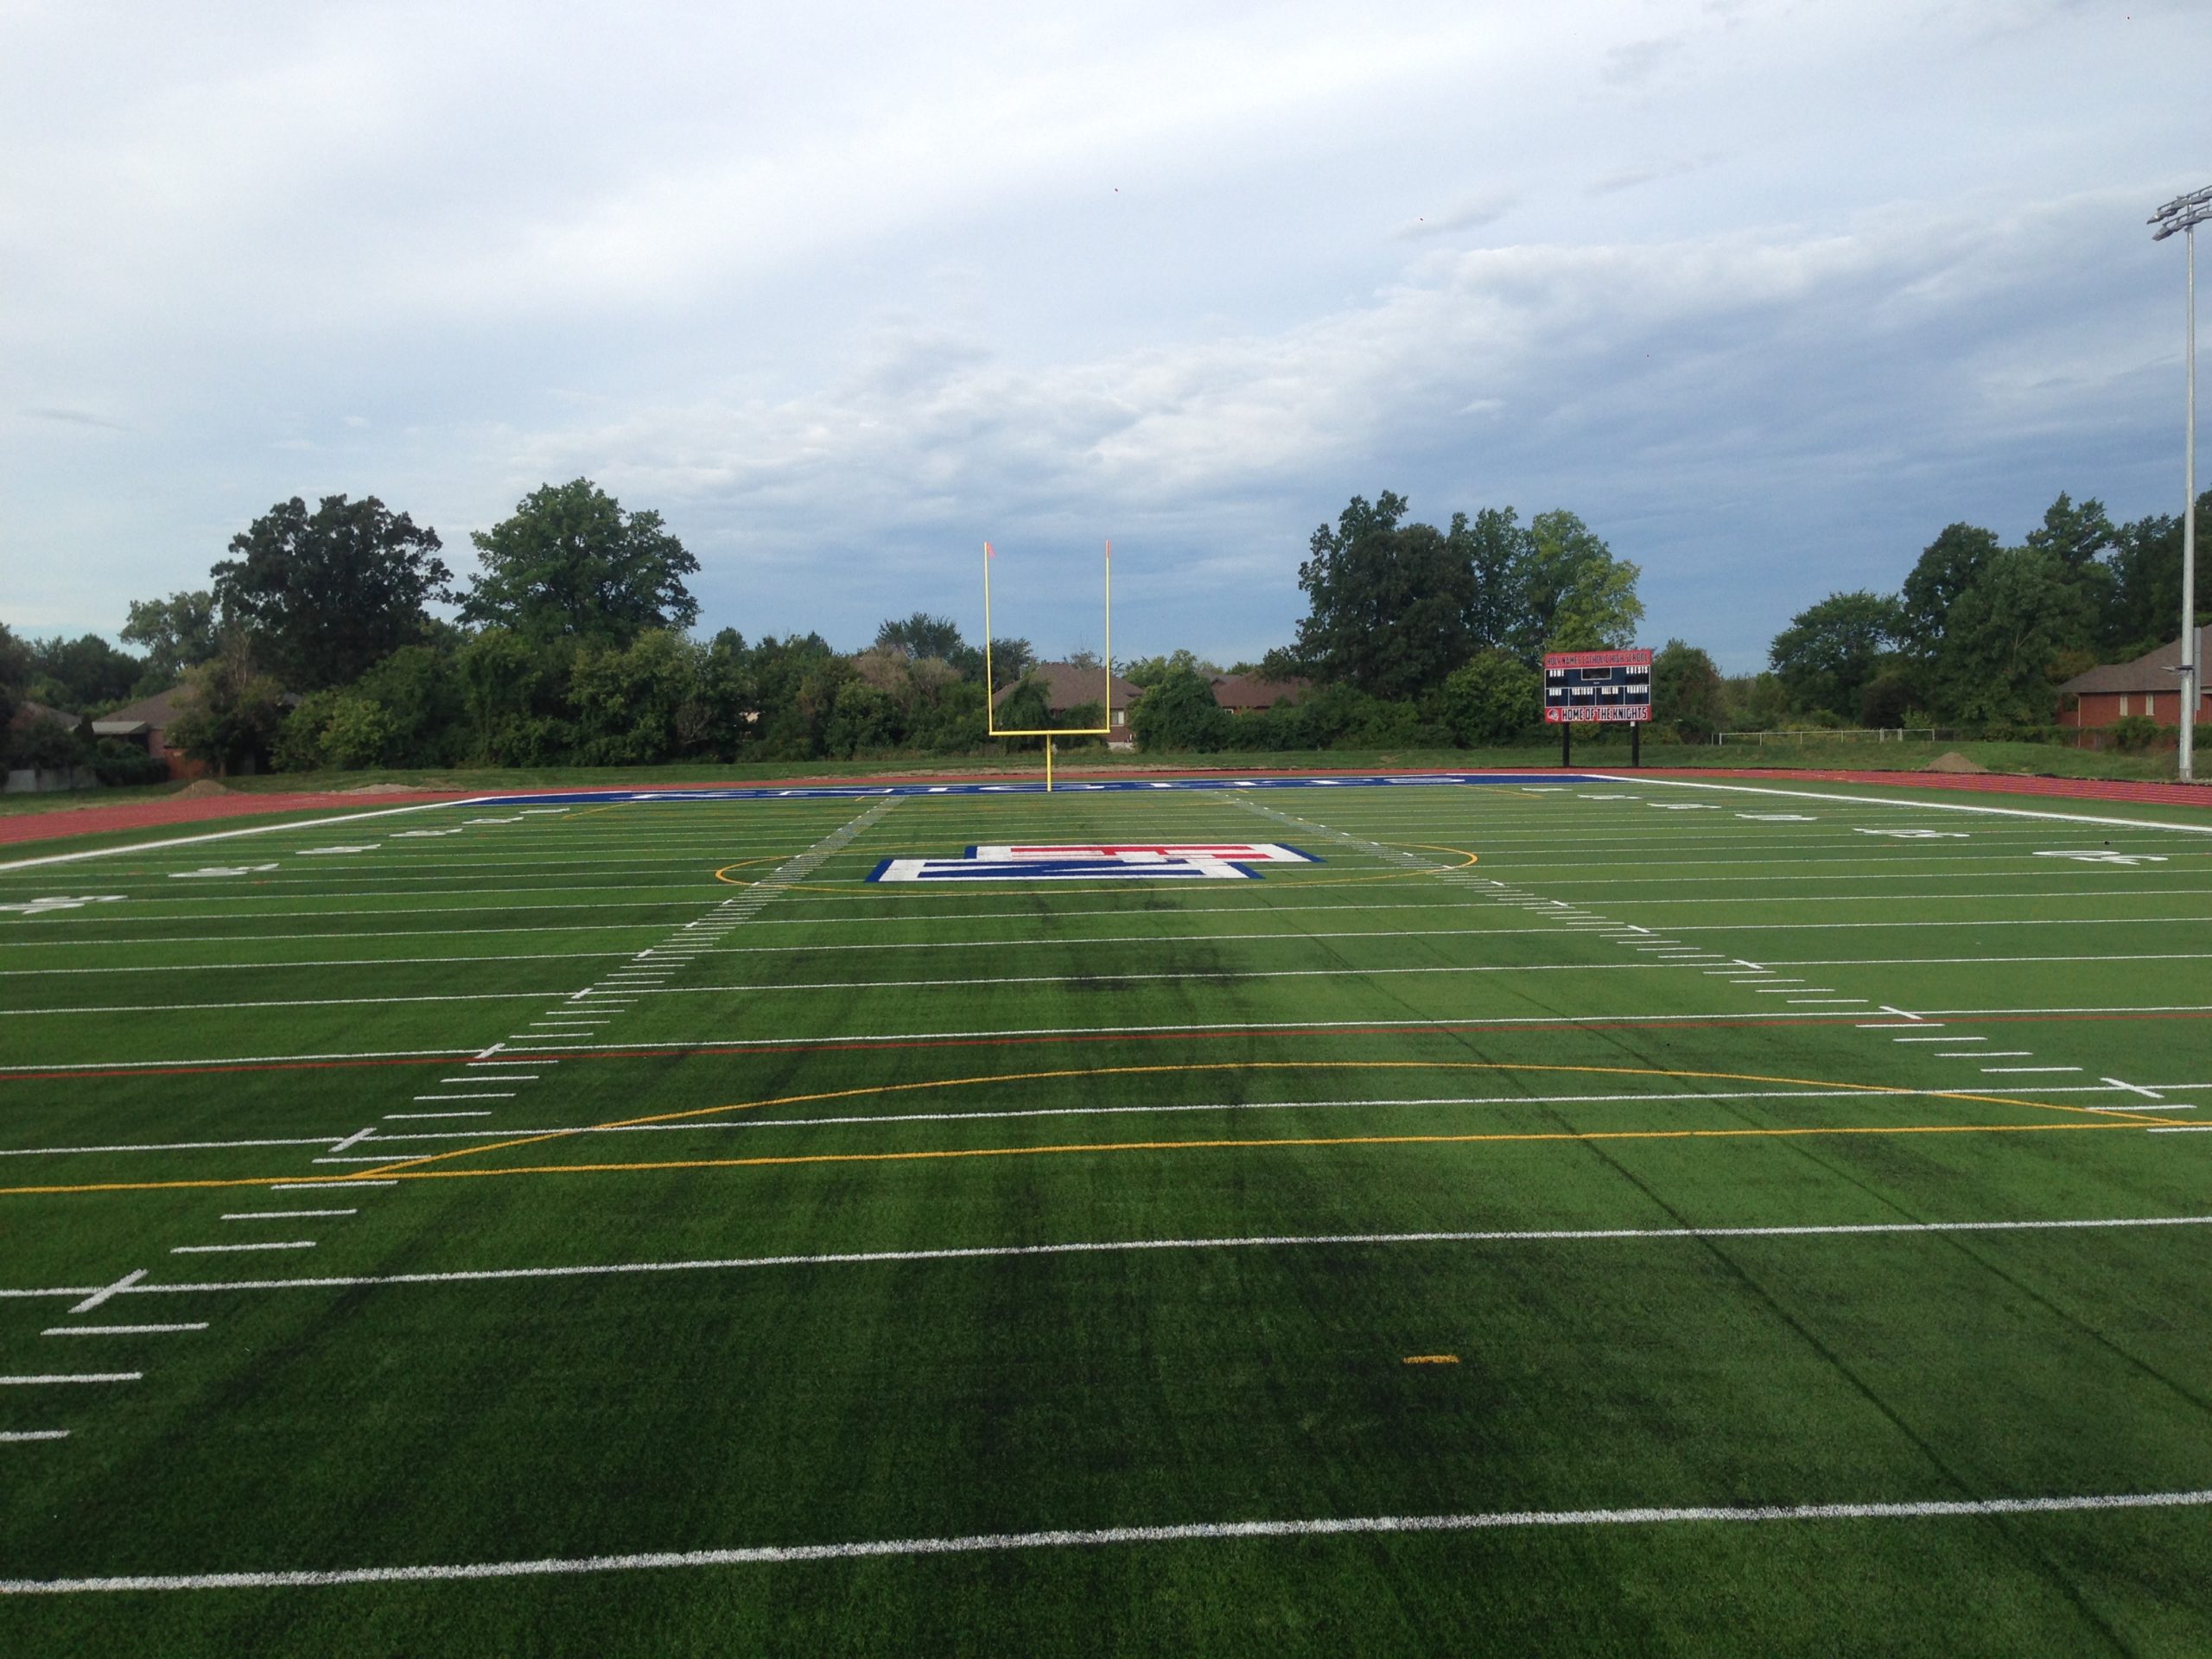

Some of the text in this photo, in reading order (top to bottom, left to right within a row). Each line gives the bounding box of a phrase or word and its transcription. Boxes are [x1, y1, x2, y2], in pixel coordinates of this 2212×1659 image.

[1561, 706, 1648, 721] HOME OF THE KNIGHTS
